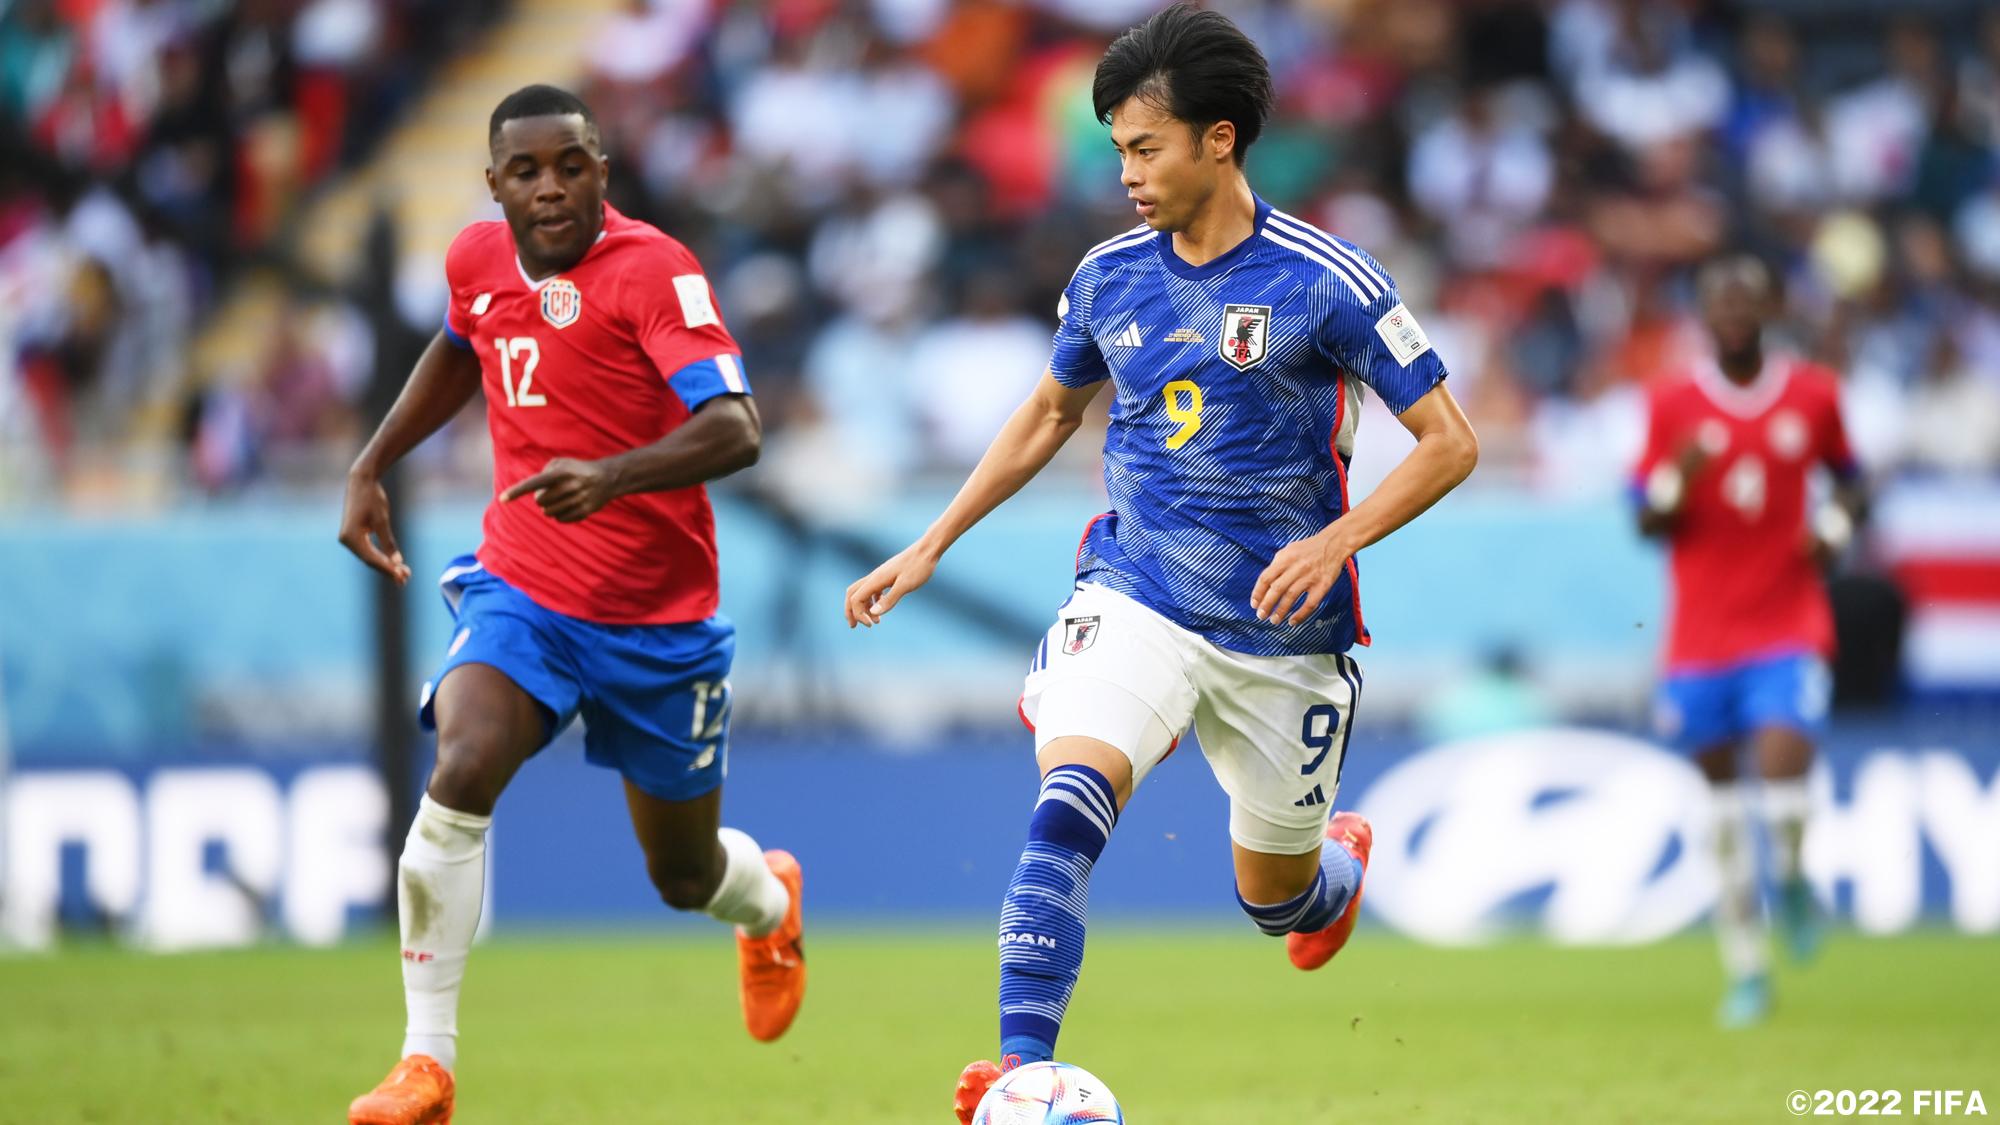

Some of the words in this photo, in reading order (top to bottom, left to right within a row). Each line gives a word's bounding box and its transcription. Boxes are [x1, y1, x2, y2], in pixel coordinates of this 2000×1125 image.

[551, 290, 572, 317] CR
[494, 336, 548, 407] 12
[1231, 348, 1252, 359] JFA
[1162, 379, 1203, 450] 9
[692, 681, 733, 740] 12
[1301, 703, 1340, 776] 9
[998, 932, 1056, 949] APAN
